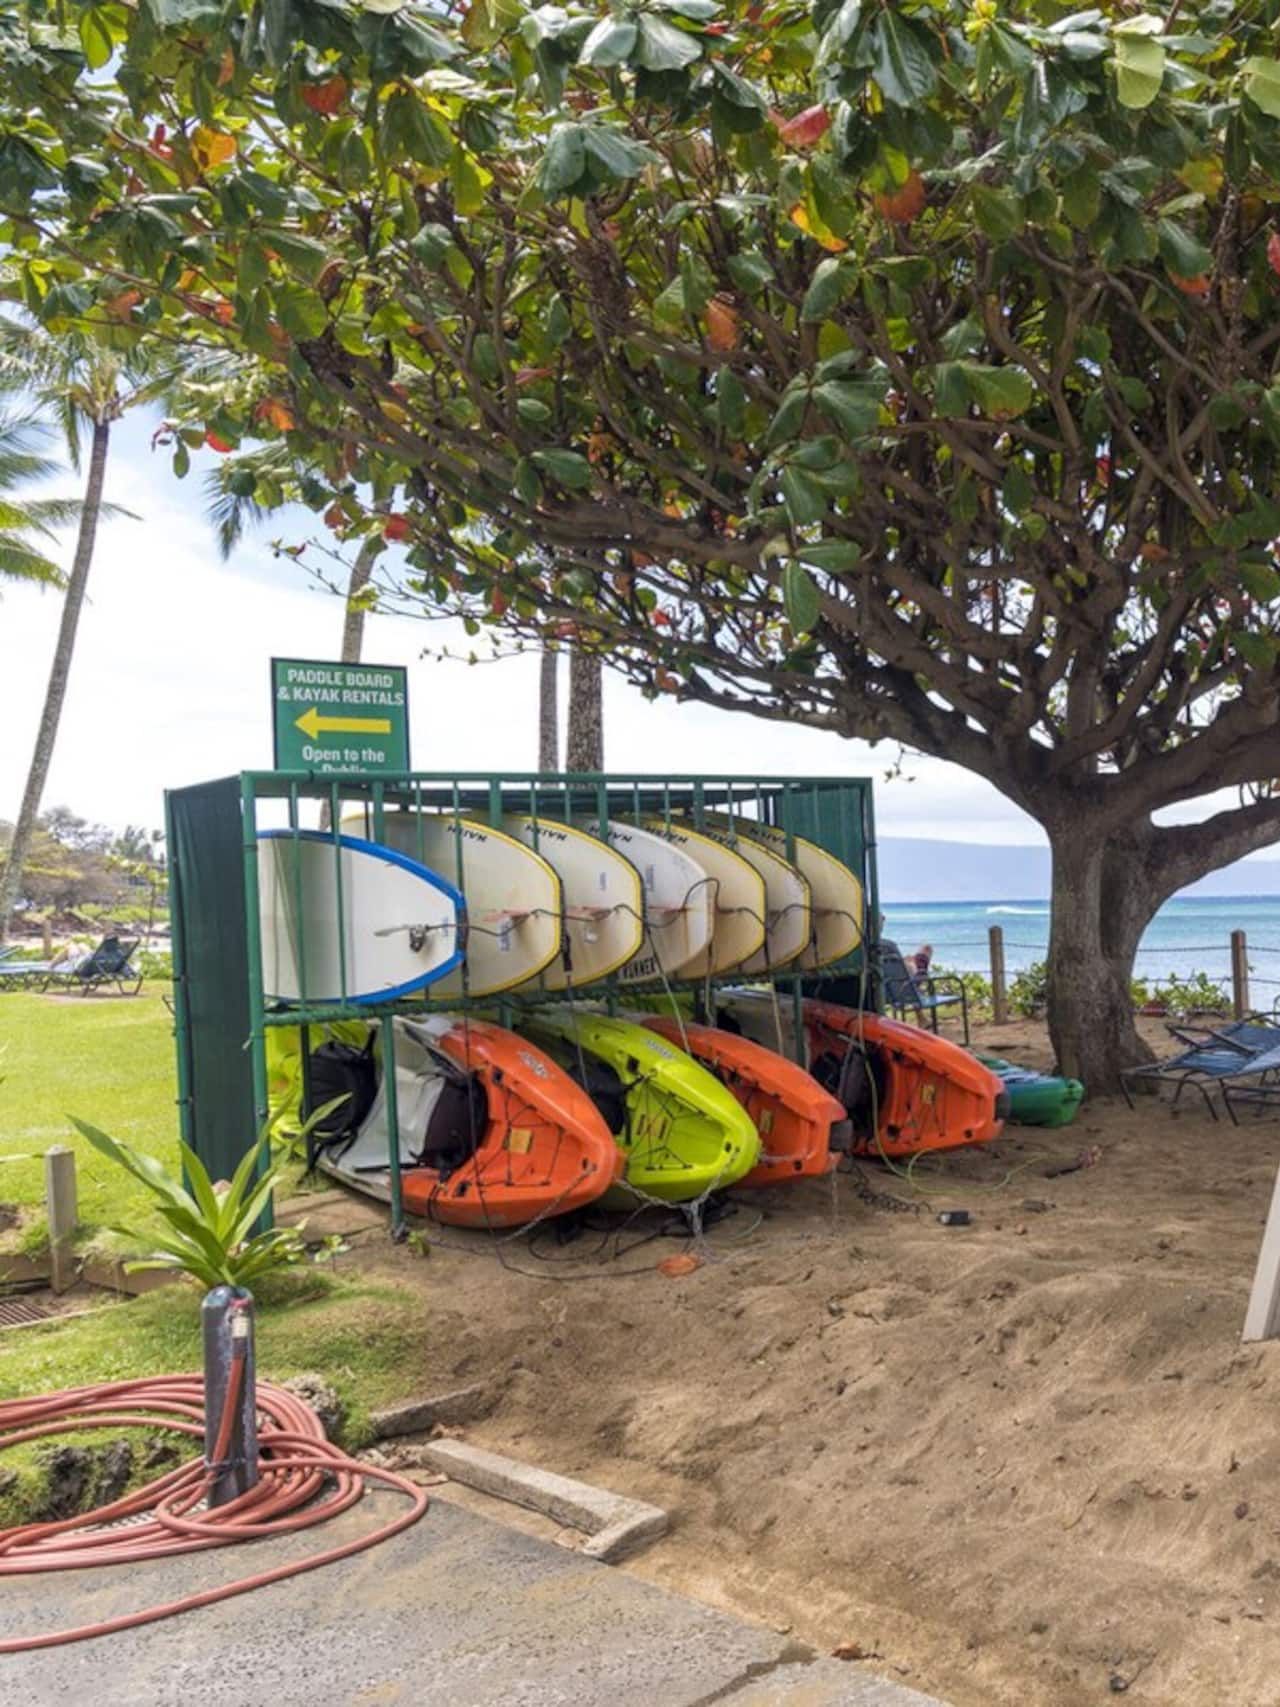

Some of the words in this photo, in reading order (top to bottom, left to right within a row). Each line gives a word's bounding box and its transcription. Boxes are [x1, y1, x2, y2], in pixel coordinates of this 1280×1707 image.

[287, 669, 343, 685] PADDLE
[345, 672, 393, 689] BOARD
[277, 686, 290, 701] &
[293, 687, 340, 703] KAYAK
[342, 689, 404, 705] RENTALS
[302, 745, 341, 763] Open
[343, 748, 359, 761] to
[361, 748, 385, 762] the
